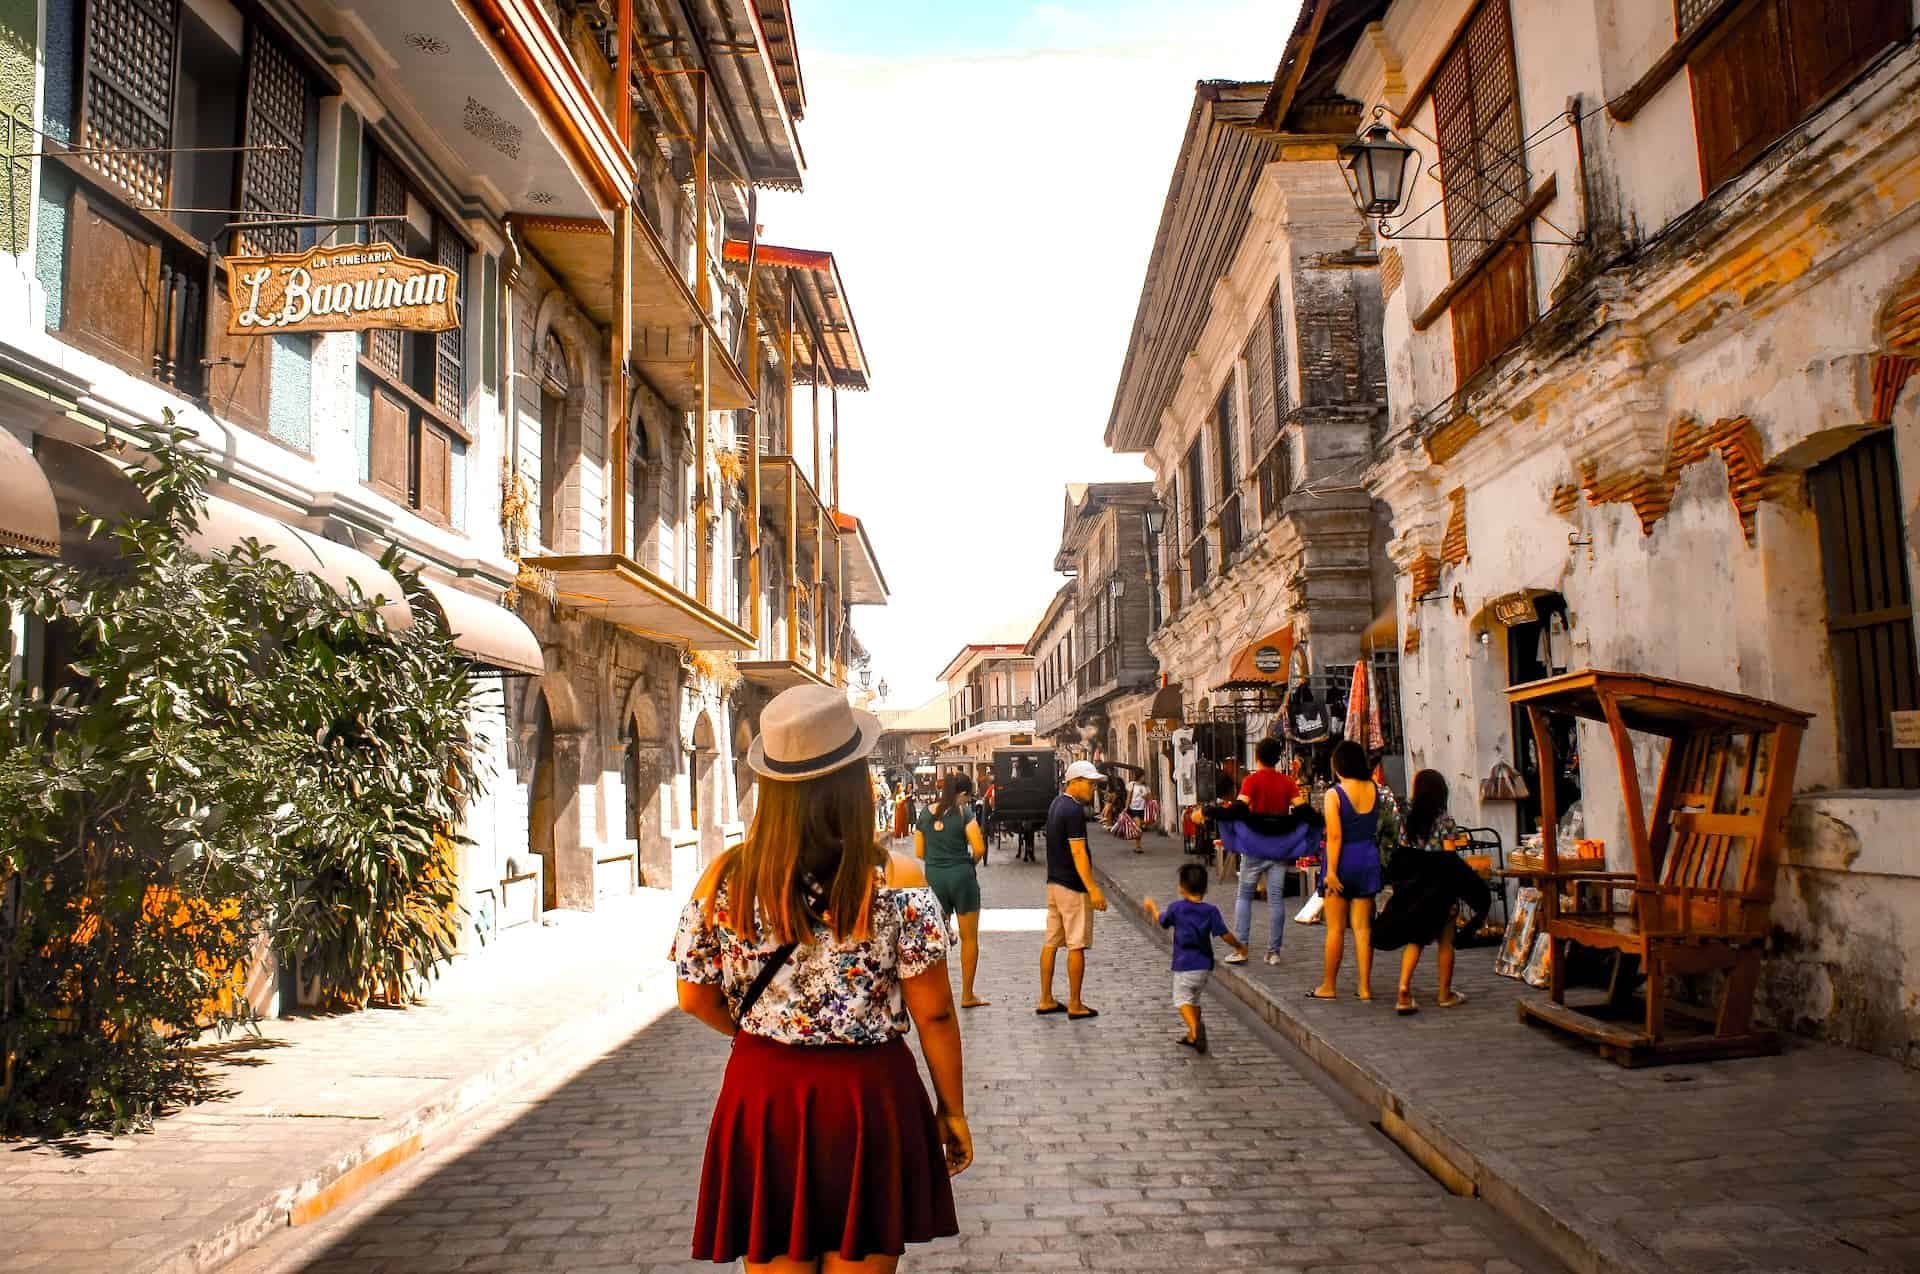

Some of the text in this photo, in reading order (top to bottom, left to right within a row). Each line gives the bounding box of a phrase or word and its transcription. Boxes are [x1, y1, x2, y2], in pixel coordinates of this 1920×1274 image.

[312, 251, 393, 268] LA FUNERARIA
[277, 266, 448, 327] Baquiran
